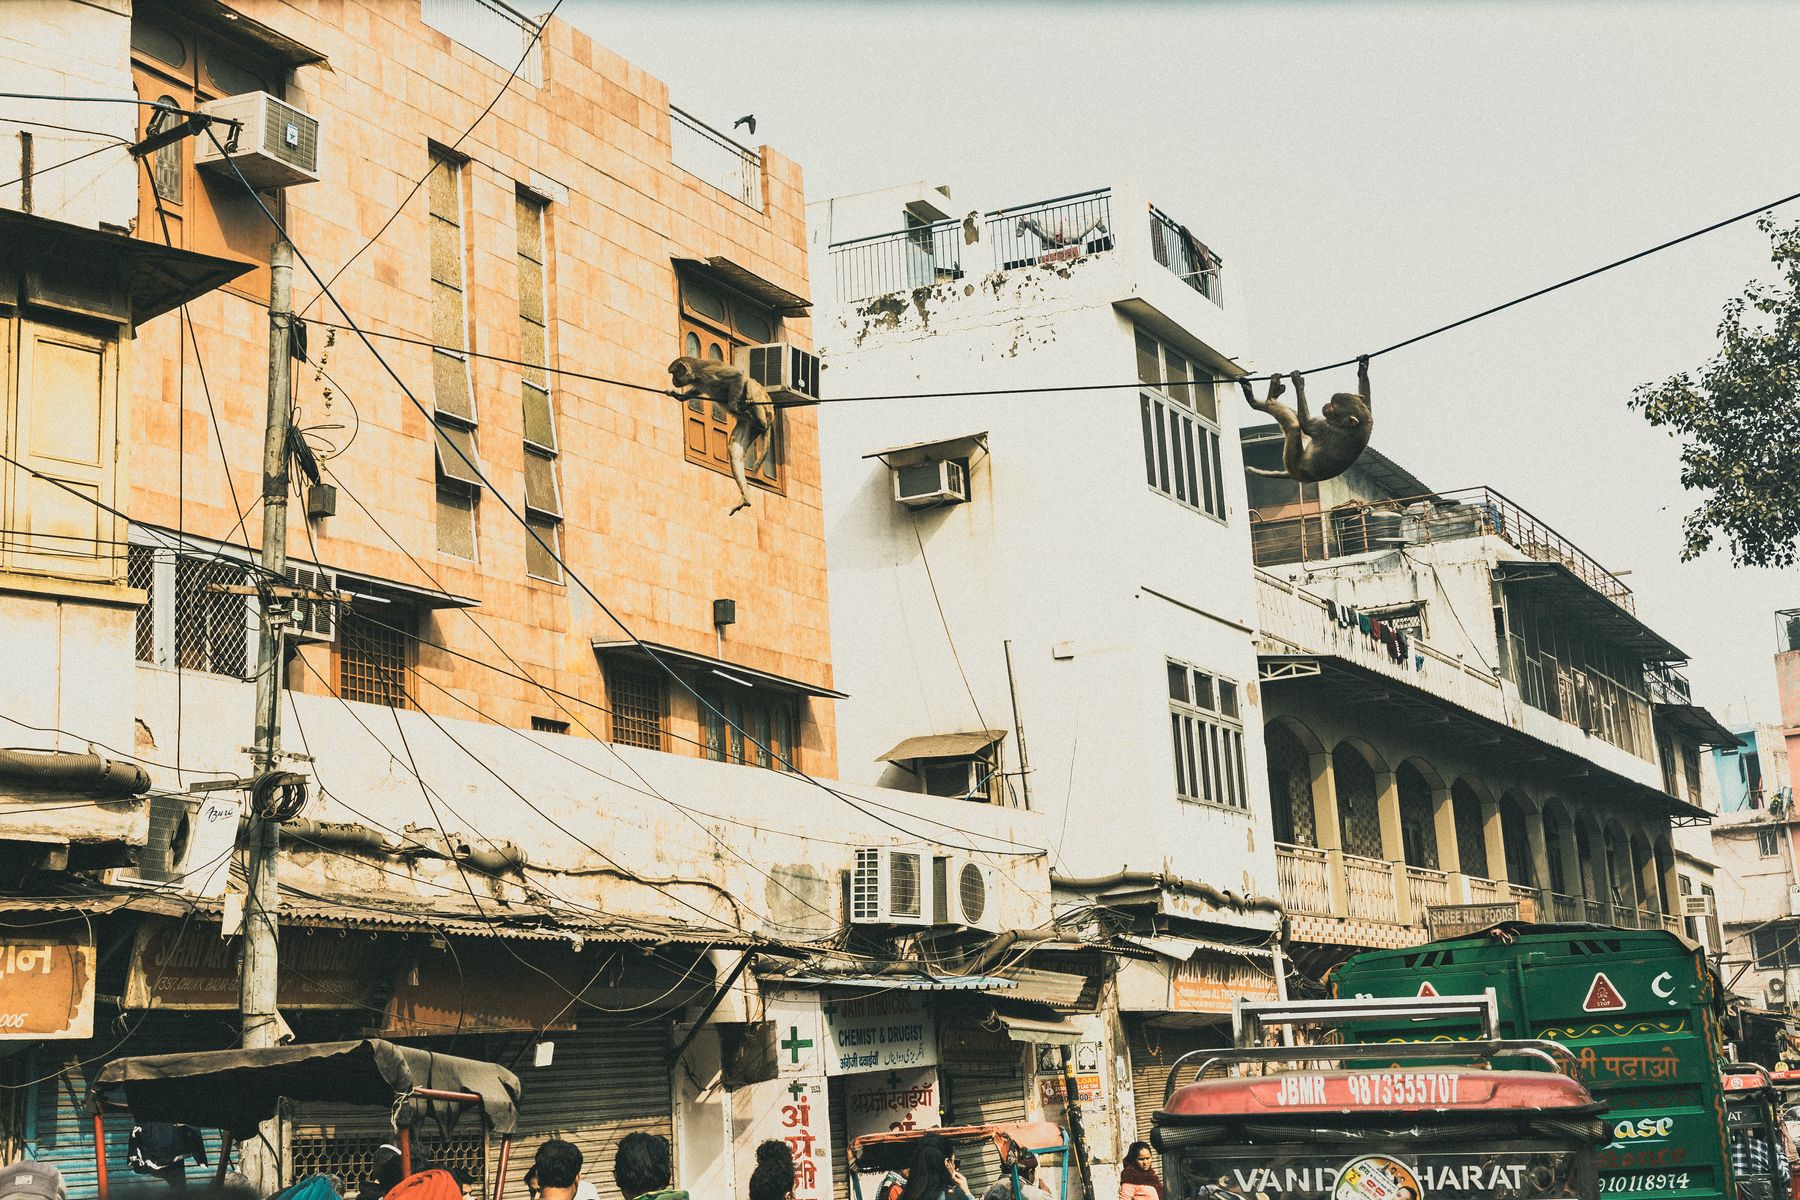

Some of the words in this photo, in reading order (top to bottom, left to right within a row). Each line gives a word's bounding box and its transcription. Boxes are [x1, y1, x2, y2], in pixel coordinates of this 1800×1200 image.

[1485, 908, 1513, 922] FOODS
[1178, 960, 1201, 983] JAIN
[1205, 962, 1225, 985] ART
[838, 1027, 876, 1047] CHEMIST
[879, 1027, 886, 1043] &
[888, 1024, 923, 1042] DRUGIST
[1277, 1076, 1327, 1106] JBMR
[1348, 1073, 1459, 1105] 9873555707
[1613, 1117, 1674, 1139] ase
[1728, 1111, 1742, 1122] AT
[1233, 1167, 1337, 1193] VAND
[1412, 1165, 1527, 1191] HARAT
